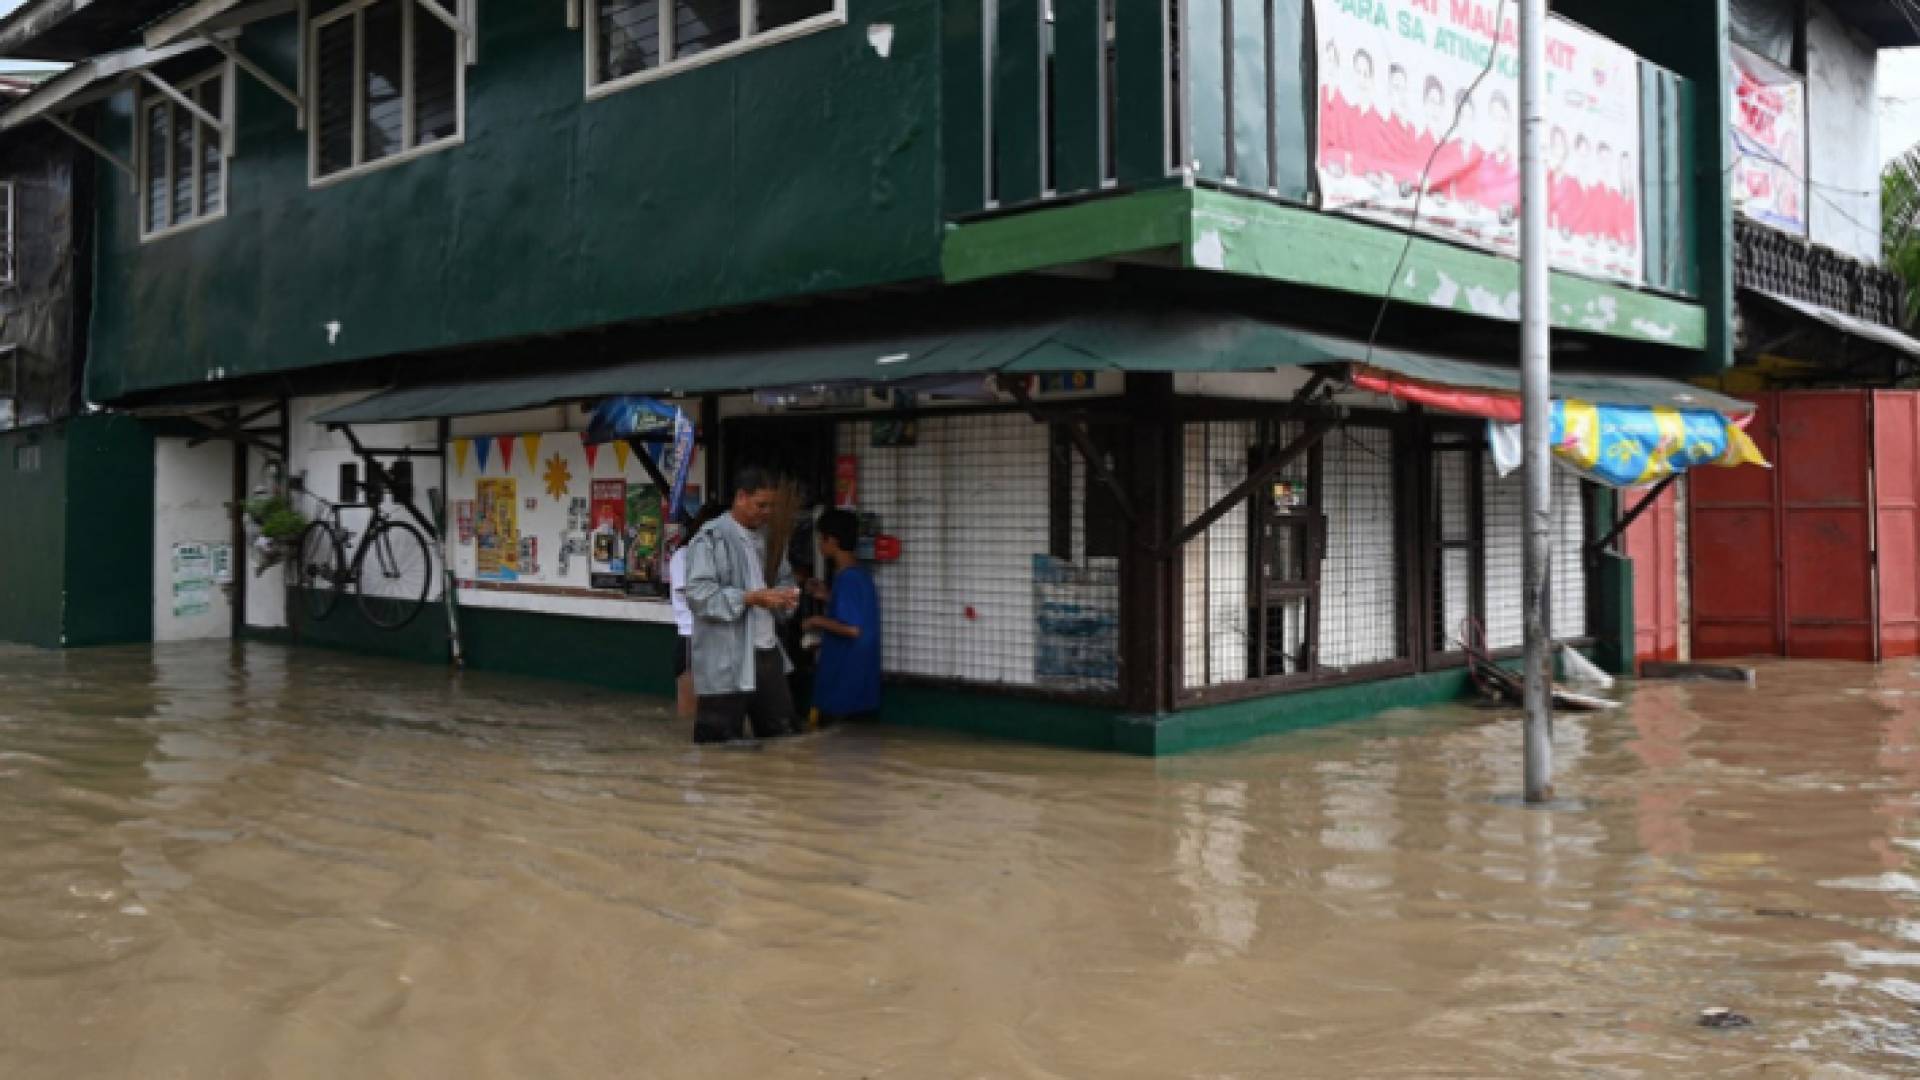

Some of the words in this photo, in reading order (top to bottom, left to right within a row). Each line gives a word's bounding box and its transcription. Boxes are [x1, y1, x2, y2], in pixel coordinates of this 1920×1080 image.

[1335, 0, 1389, 29] ARA
[1398, 10, 1426, 44] SA
[1451, 0, 1577, 73] MALAKIT
